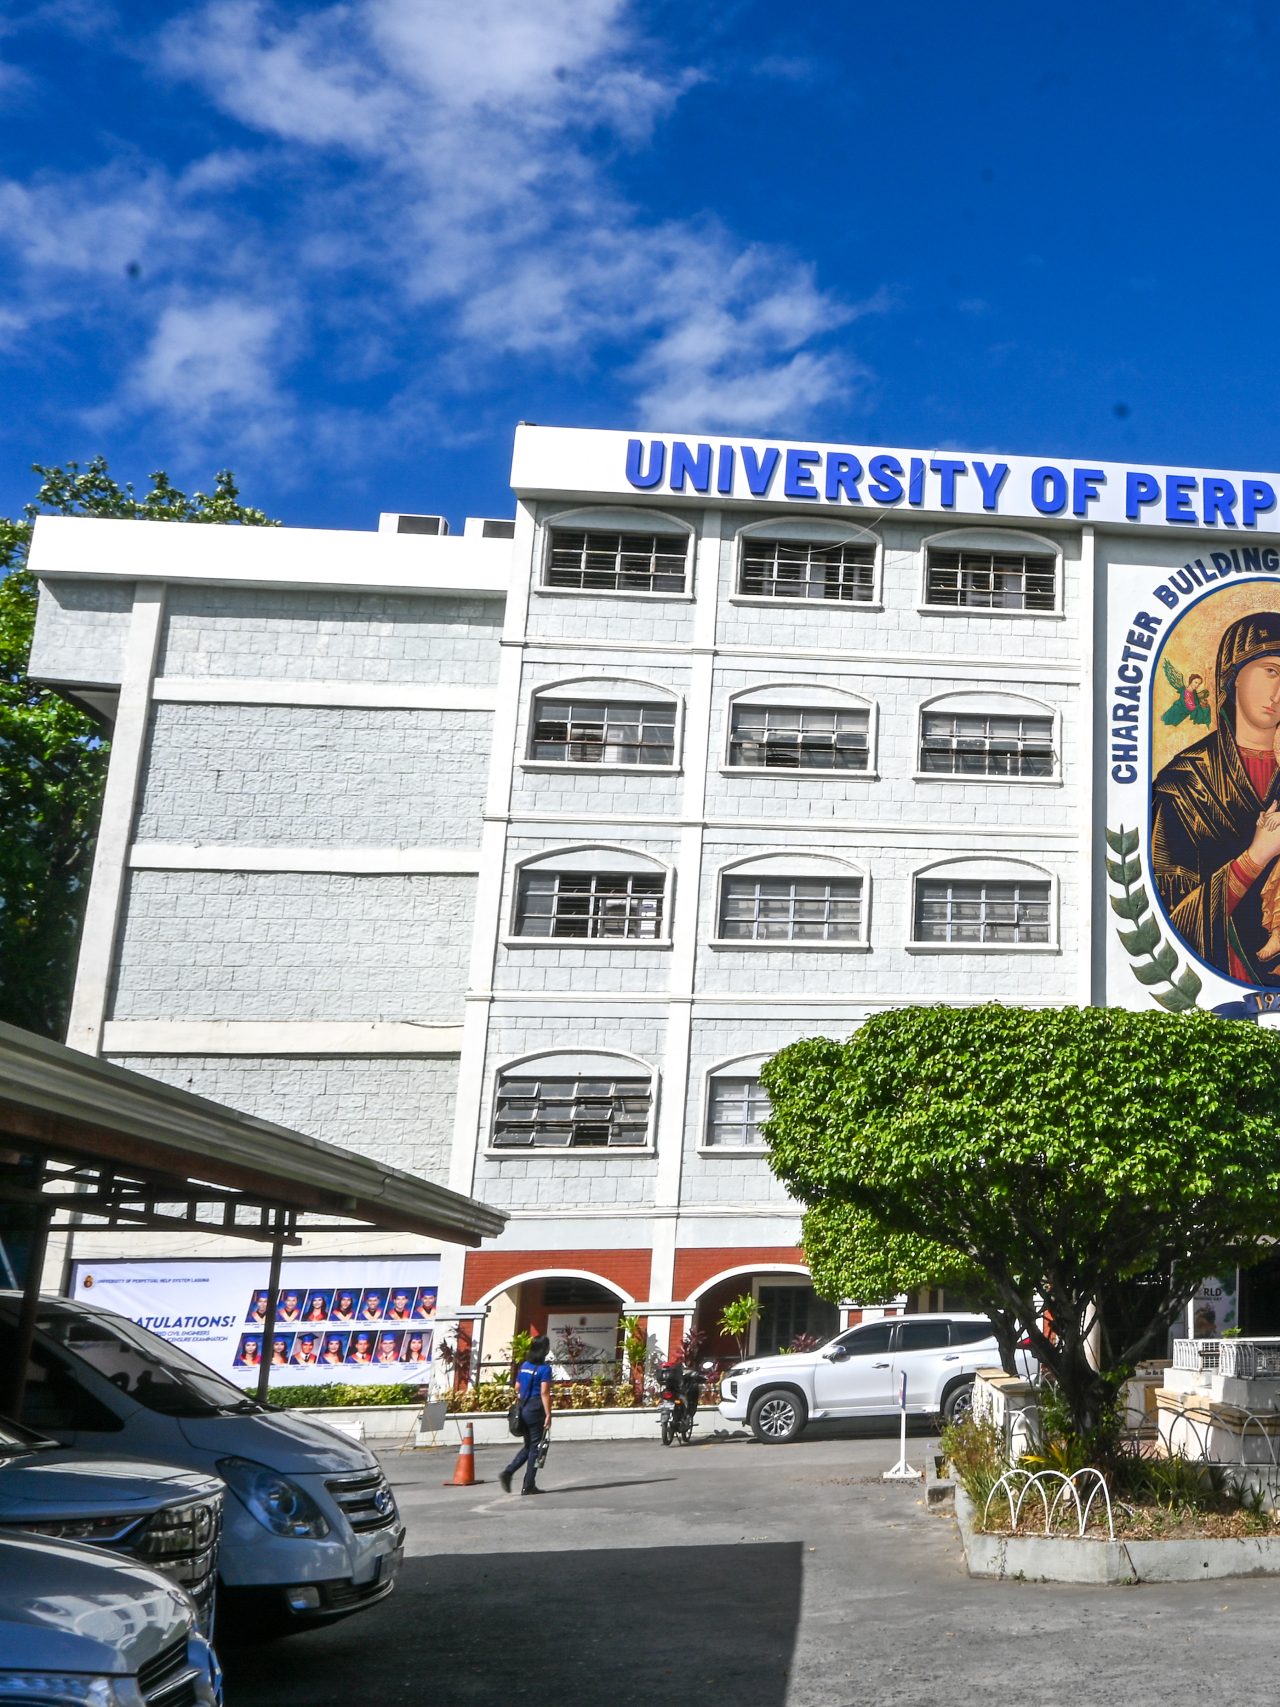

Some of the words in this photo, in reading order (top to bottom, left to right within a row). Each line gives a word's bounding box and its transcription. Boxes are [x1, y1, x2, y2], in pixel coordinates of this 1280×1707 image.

[625, 439, 1010, 509] UNIVERSITY
[1031, 466, 1105, 515] OF
[1111, 611, 1163, 785] CHARACTER
[1153, 547, 1280, 610] BUILDING
[1203, 1287, 1223, 1297] RLD
[129, 1315, 236, 1329] ATULATIONS!
